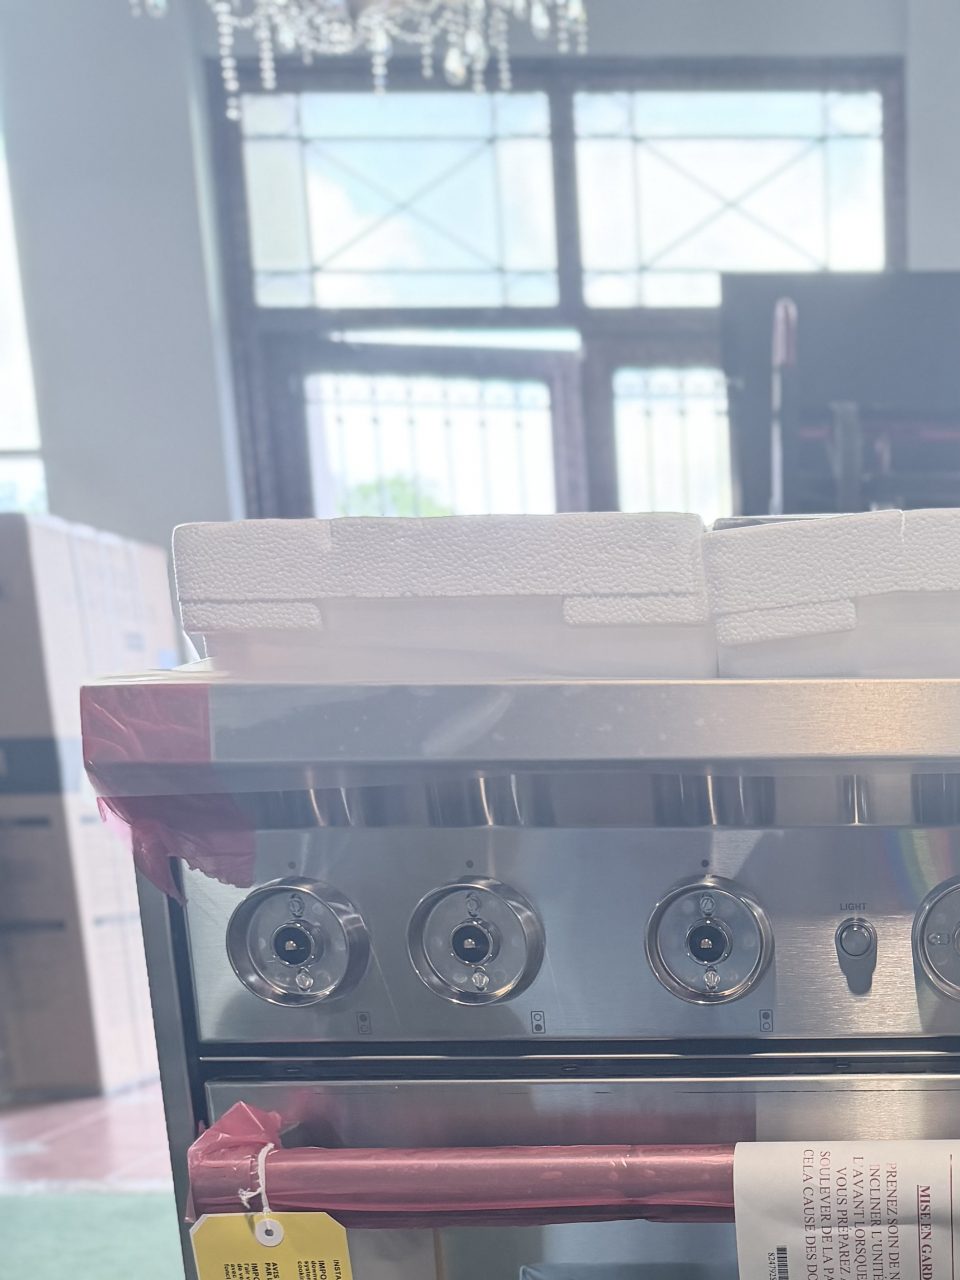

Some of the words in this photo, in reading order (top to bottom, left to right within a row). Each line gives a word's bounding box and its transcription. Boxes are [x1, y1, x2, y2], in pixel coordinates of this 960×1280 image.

[839, 903, 868, 911] LIGHT
[801, 1149, 816, 1185] CELA
[818, 1150, 834, 1226] SOULEVER
[835, 1167, 849, 1206] VOUS
[851, 1156, 866, 1219] L'AVANT
[868, 1163, 883, 1227] INCLINER
[885, 1162, 899, 1216] PRENEZ
[918, 1185, 932, 1220] MISE
[803, 1186, 818, 1232] CAUSE
[805, 1235, 819, 1261] DES
[821, 1225, 834, 1243] DE
[836, 1208, 852, 1275] PRÉPAREZ
[887, 1218, 900, 1249] SOIN
[919, 1223, 933, 1240] EN
[822, 1246, 835, 1264] LA
[853, 1221, 868, 1280] LORSQUE
[888, 1251, 900, 1269] DE
[265, 1261, 274, 1276] PAR
